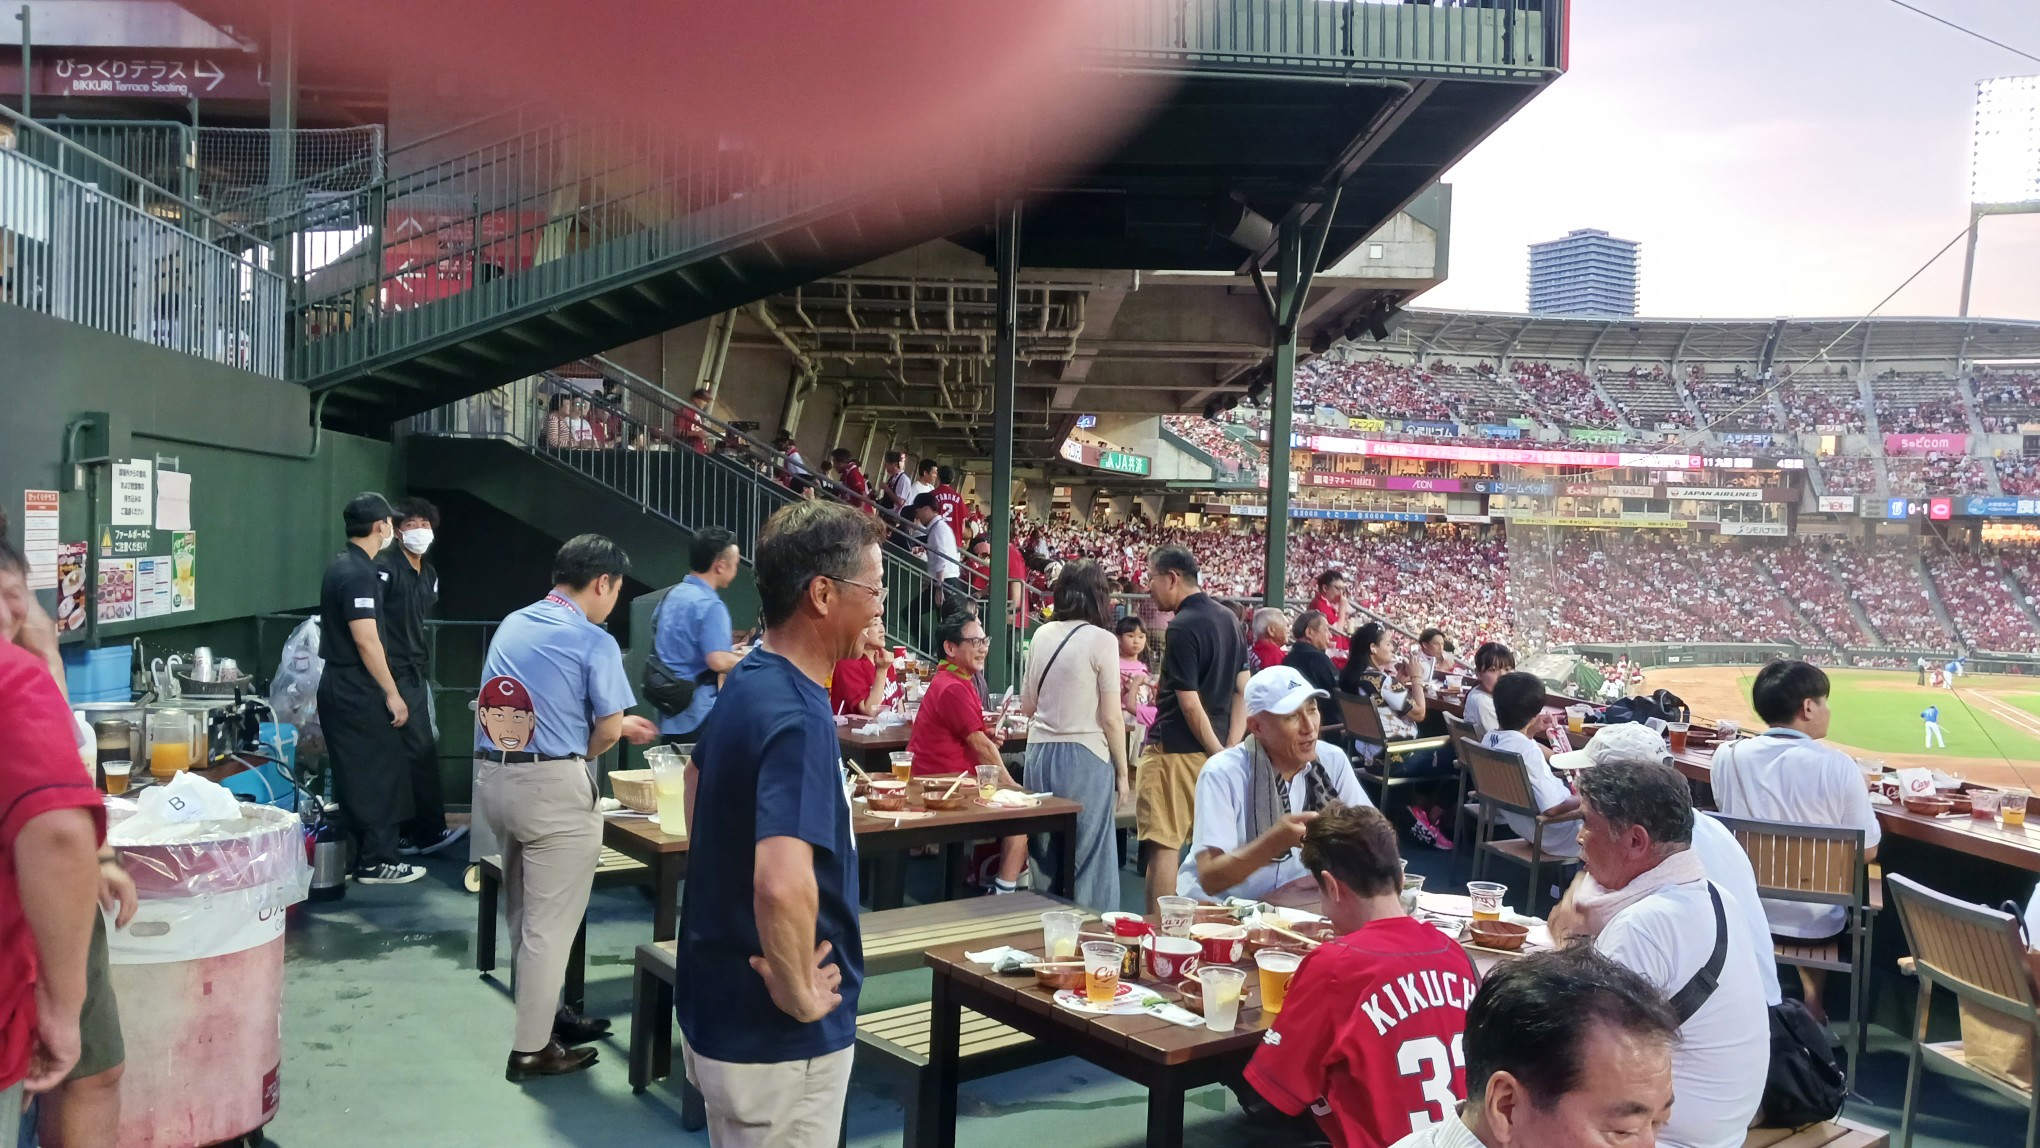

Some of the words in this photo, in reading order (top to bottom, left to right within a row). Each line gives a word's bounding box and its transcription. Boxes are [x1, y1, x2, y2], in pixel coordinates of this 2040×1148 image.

[56, 59, 187, 79] びっくりテラス
[73, 80, 113, 92] BIKKURI
[115, 80, 149, 92] Terrace
[152, 81, 188, 96] Seating
[1494, 482, 1549, 493] ドリームベッド
[1714, 490, 1759, 498] AIRLINES
[942, 503, 954, 522] 2
[1907, 502, 1928, 515] 0-1
[498, 680, 515, 696] C
[1886, 786, 1900, 799] Ca
[168, 796, 186, 812] B
[1179, 955, 1200, 978] Ca
[1396, 1031, 1465, 1134] 3
